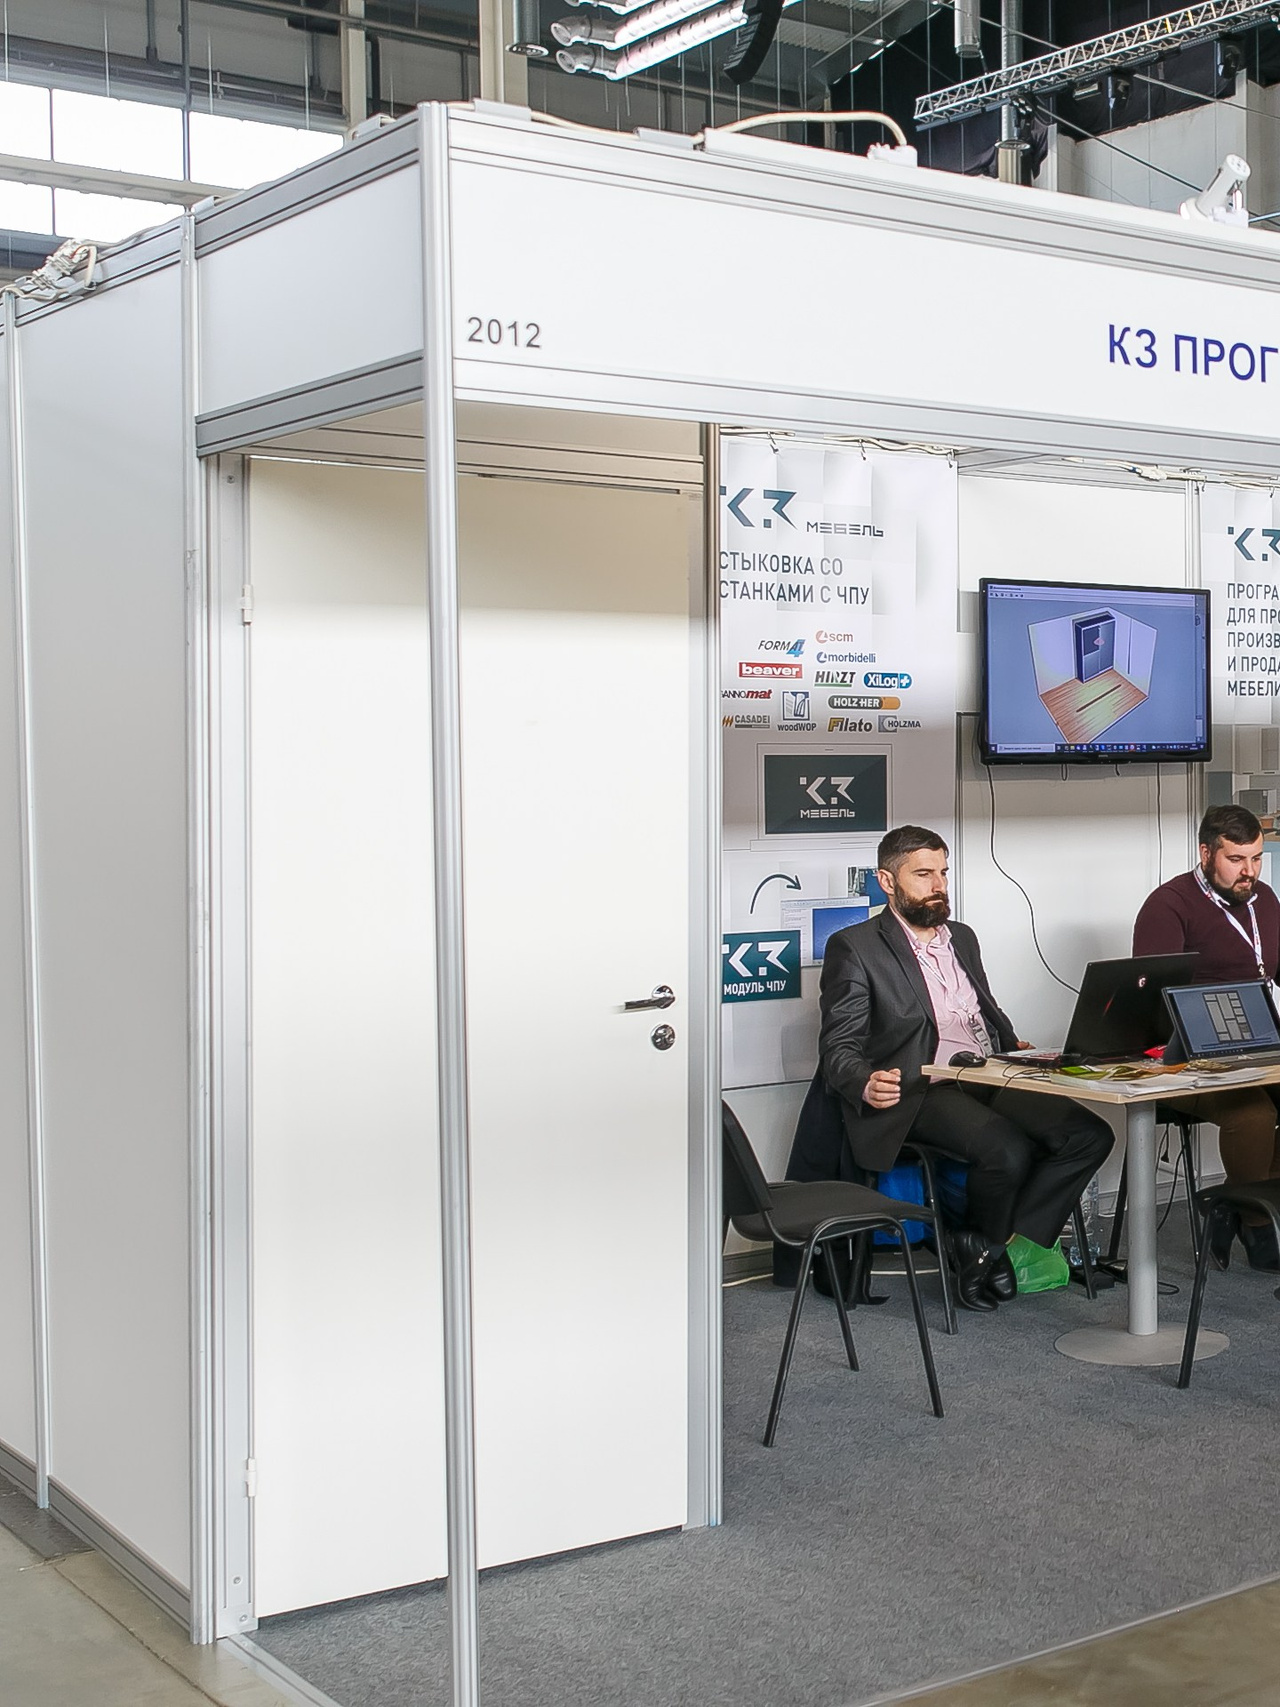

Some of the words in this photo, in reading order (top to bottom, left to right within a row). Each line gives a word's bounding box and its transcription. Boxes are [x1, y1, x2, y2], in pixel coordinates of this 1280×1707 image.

[468, 316, 542, 349] 2012
[806, 521, 884, 538] МЕБЕЛЬ
[720, 551, 815, 575] СТЫКОВКА
[820, 557, 843, 576] СО
[720, 580, 813, 603] СТАНКАМИ
[820, 585, 831, 603] С
[837, 586, 870, 605] ЧПУ
[1226, 607, 1256, 626] ДЛЯ
[828, 652, 876, 663] morbidelli
[1227, 656, 1236, 672] И
[741, 664, 799, 676] beaver
[735, 714, 771, 724] CASADEI
[887, 720, 921, 728] HOLZMA
[800, 808, 856, 819] МЕБЕЛЬ
[723, 981, 765, 997] МОДУЛЬ
[766, 979, 787, 992] ЧПУ
